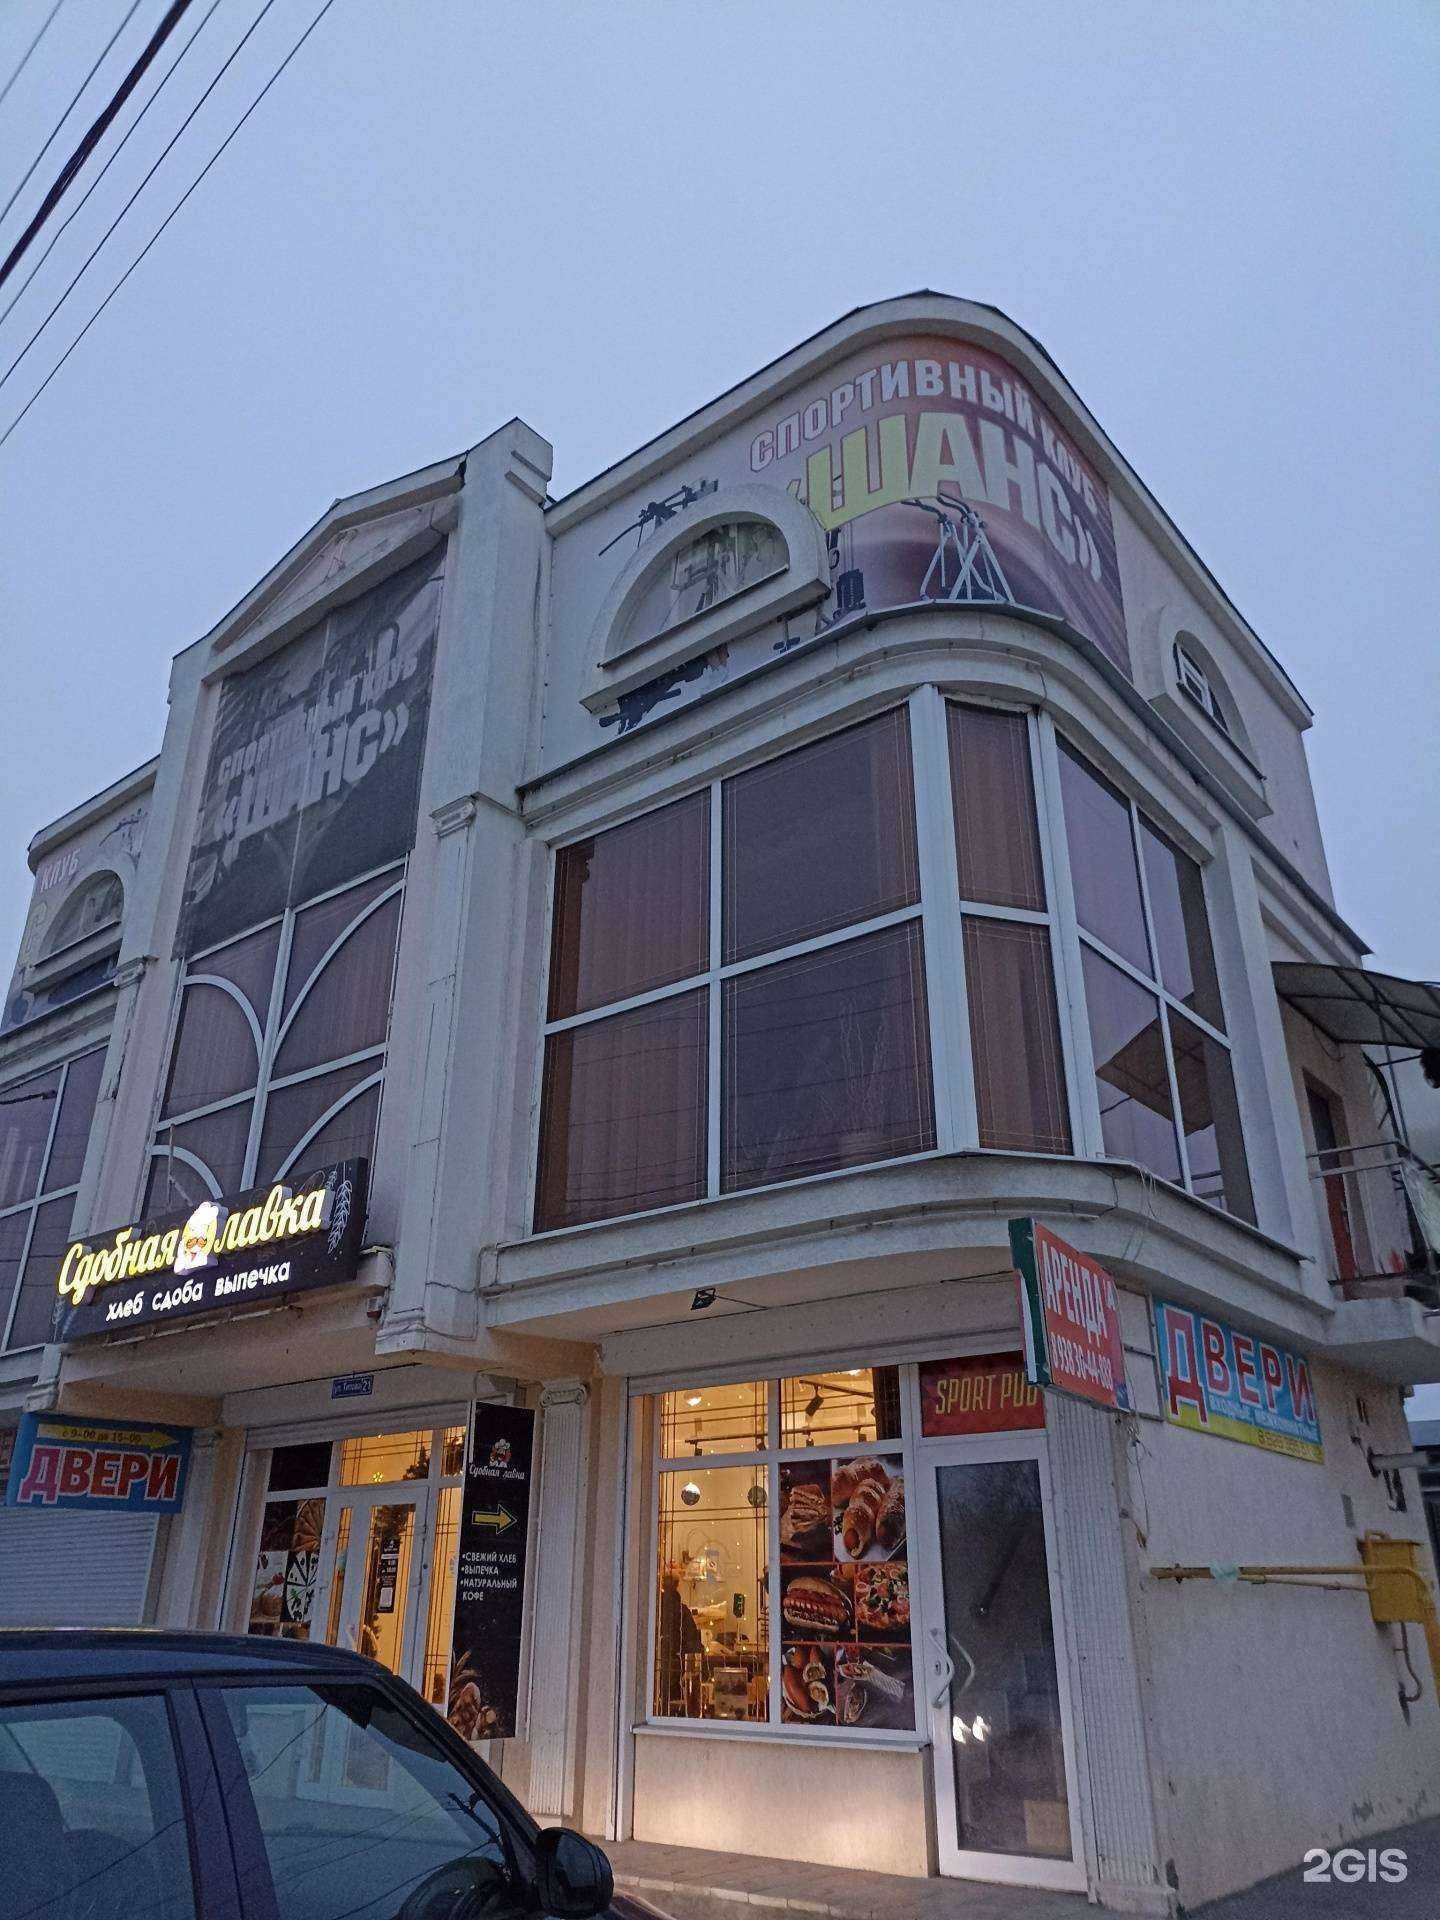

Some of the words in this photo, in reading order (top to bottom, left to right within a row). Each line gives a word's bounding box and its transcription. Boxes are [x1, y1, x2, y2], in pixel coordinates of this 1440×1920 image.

[750, 358, 1037, 472] СПОРТИВНЫЙ
[1038, 415, 1098, 515] КЛУБ
[40, 848, 81, 893] КЛУБ
[57, 1226, 181, 1306] Сдобная
[213, 1184, 327, 1254] лавка
[105, 1291, 144, 1322] хлеб
[151, 1278, 204, 1312] сдоба
[214, 1260, 291, 1297] выпечка
[1042, 1240, 1107, 1348] АРЕНДА
[935, 1374, 996, 1415] SPORT
[1163, 1303, 1318, 1428] ДВЕРИ
[17, 1444, 182, 1504] ДВЕРИ
[469, 1463, 500, 1478] Сдобная
[503, 1468, 525, 1480] лавка
[499, 1553, 517, 1563] ХЛЕБ
[462, 1591, 485, 1601] КОФЕ
